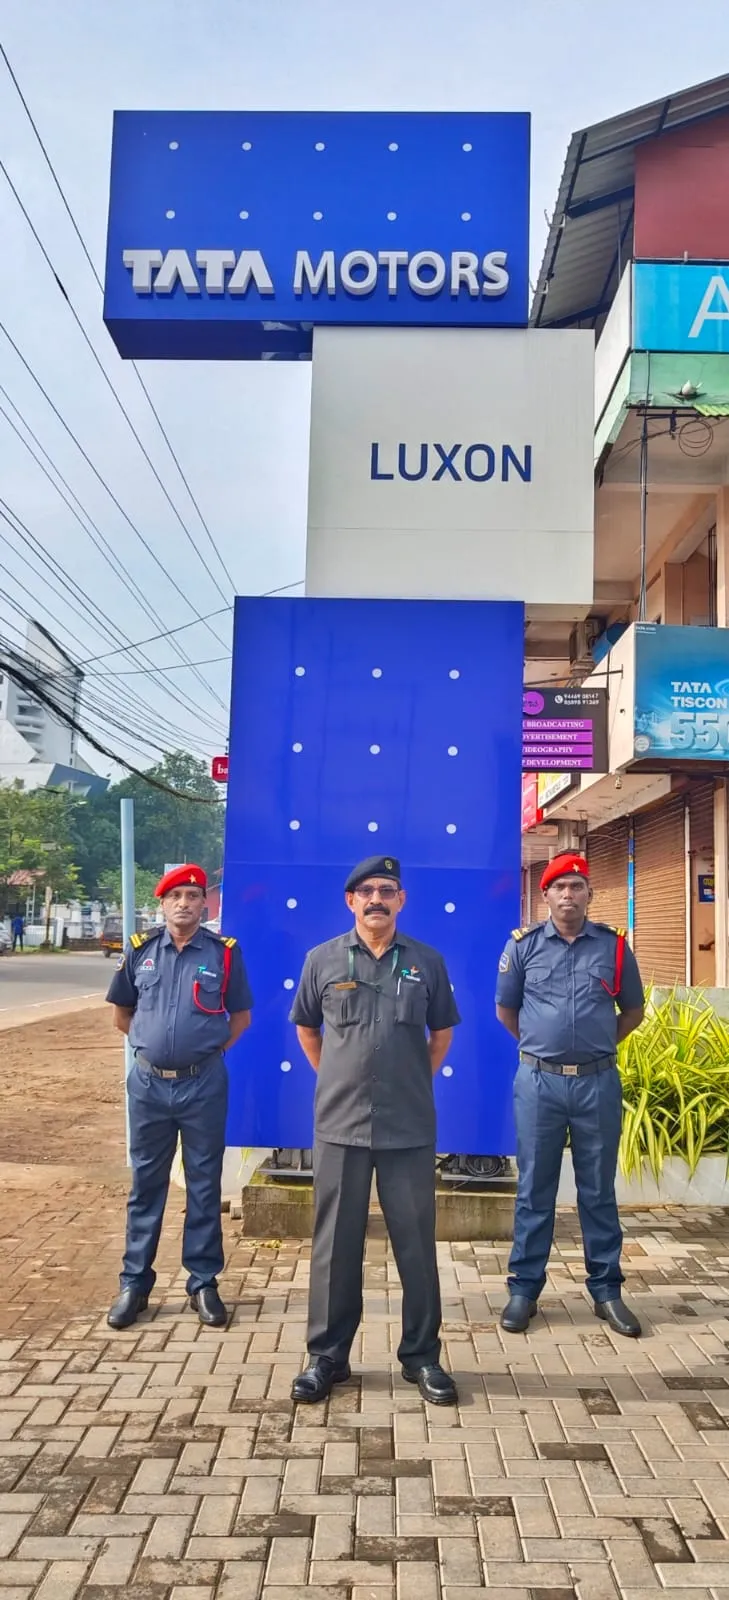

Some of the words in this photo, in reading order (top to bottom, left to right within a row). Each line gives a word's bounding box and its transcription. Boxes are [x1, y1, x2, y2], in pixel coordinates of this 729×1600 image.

[123, 249, 275, 295] TATA
[293, 250, 509, 297] MOTORS
[370, 442, 532, 482] LUXON
[670, 681, 712, 694] TATA
[670, 696, 728, 709] TISCON
